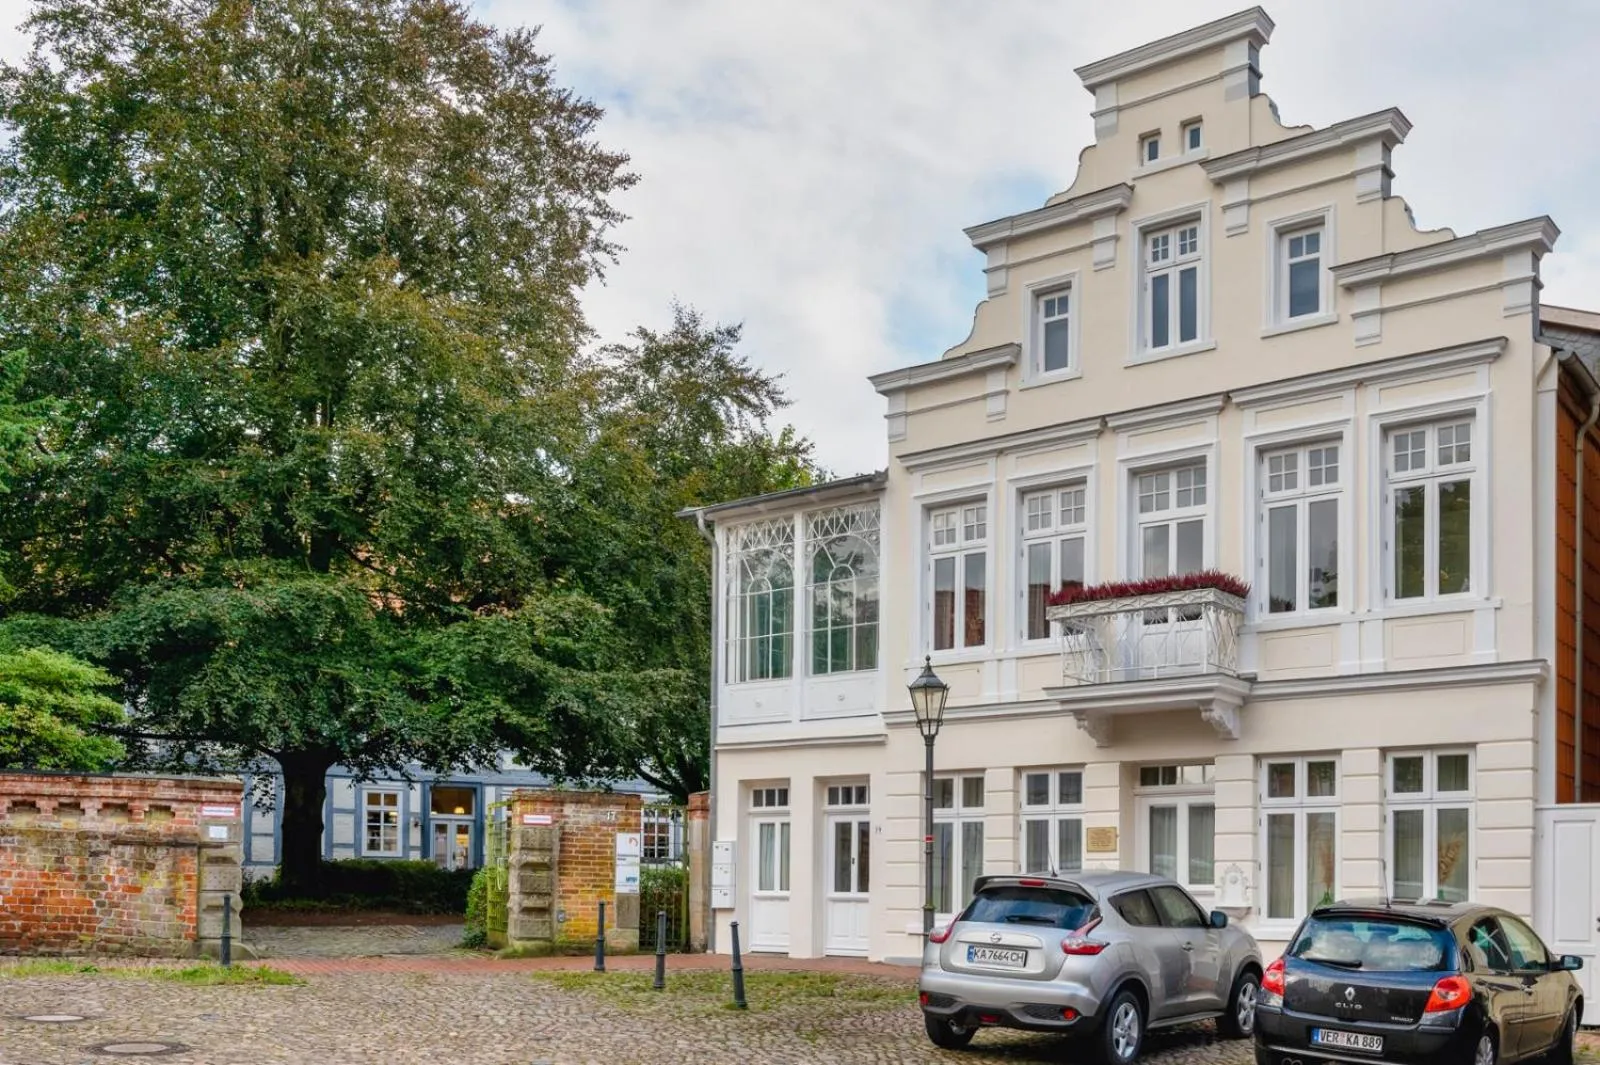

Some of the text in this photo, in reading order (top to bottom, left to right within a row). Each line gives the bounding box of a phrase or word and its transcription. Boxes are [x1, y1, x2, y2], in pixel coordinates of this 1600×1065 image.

[1320, 1031, 1382, 1049] VER KA 889
